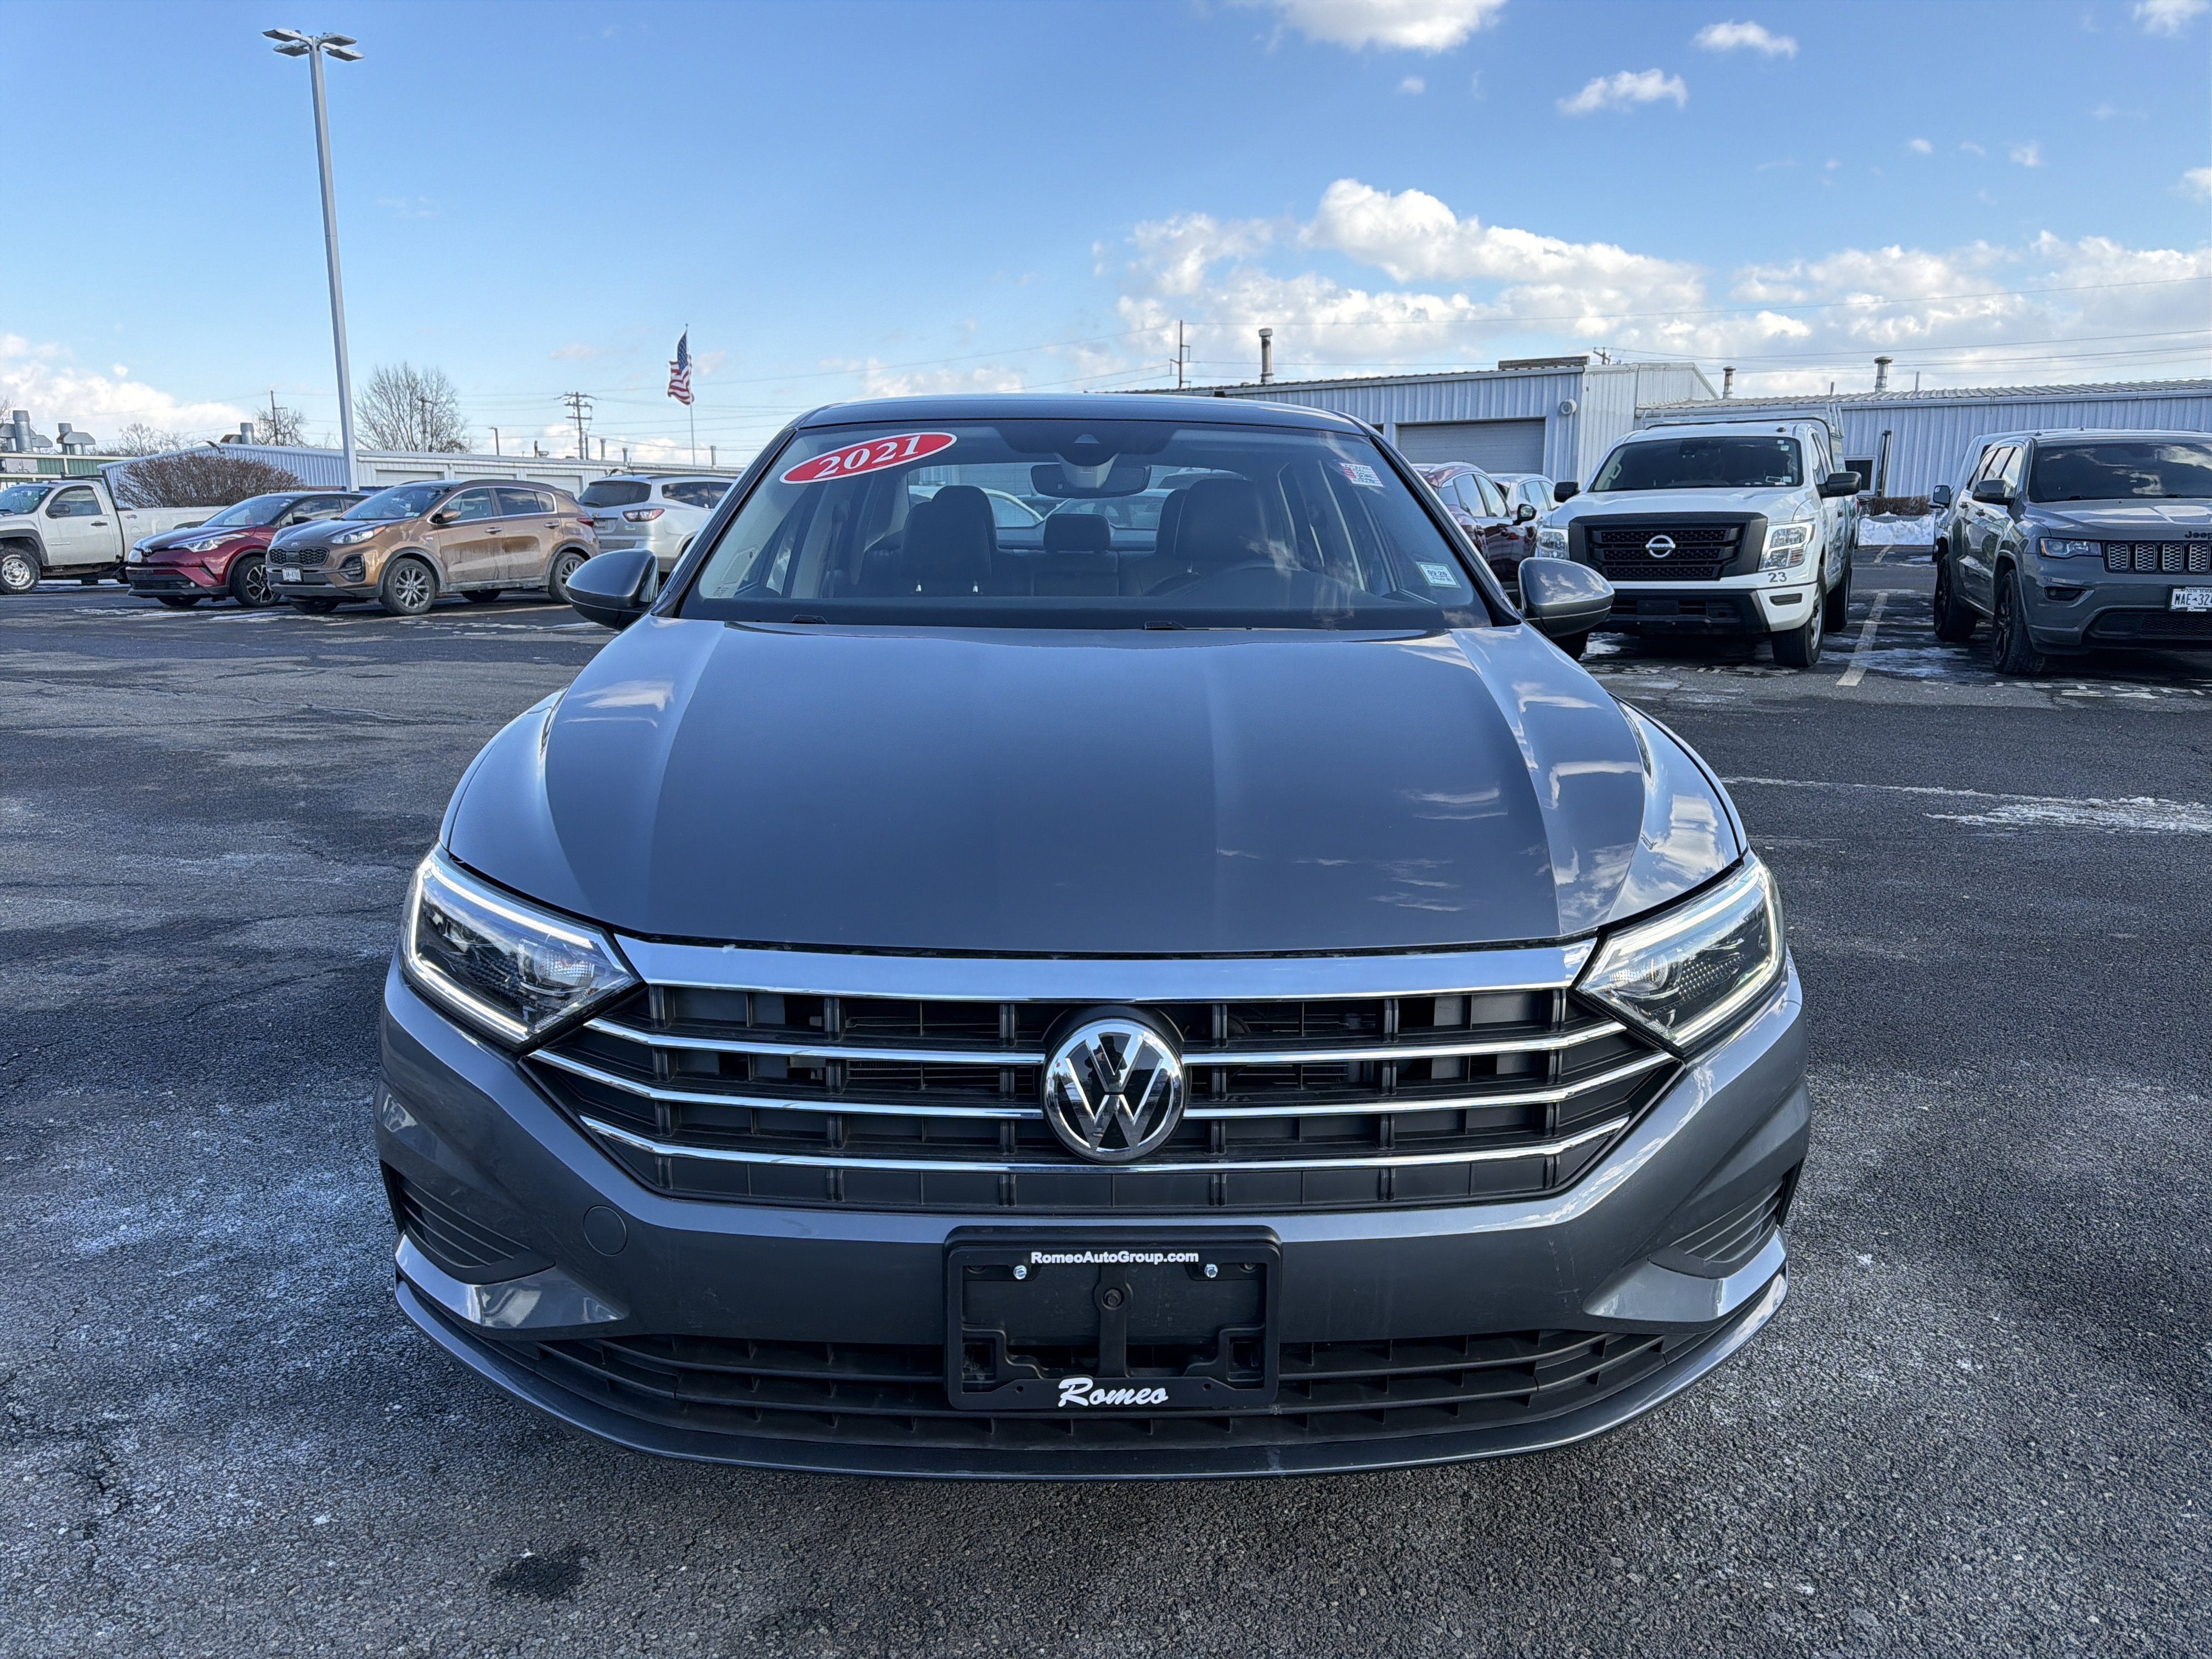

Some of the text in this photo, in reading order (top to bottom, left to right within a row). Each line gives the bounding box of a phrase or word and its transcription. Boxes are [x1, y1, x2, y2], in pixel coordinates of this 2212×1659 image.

[814, 436, 921, 478] 2021
[2184, 531, 2212, 539] Jeep
[1768, 572, 1787, 583] 23
[1031, 1251, 1199, 1265] RomeoAutoGroup.com
[1058, 1378, 1169, 1407] Romeo
